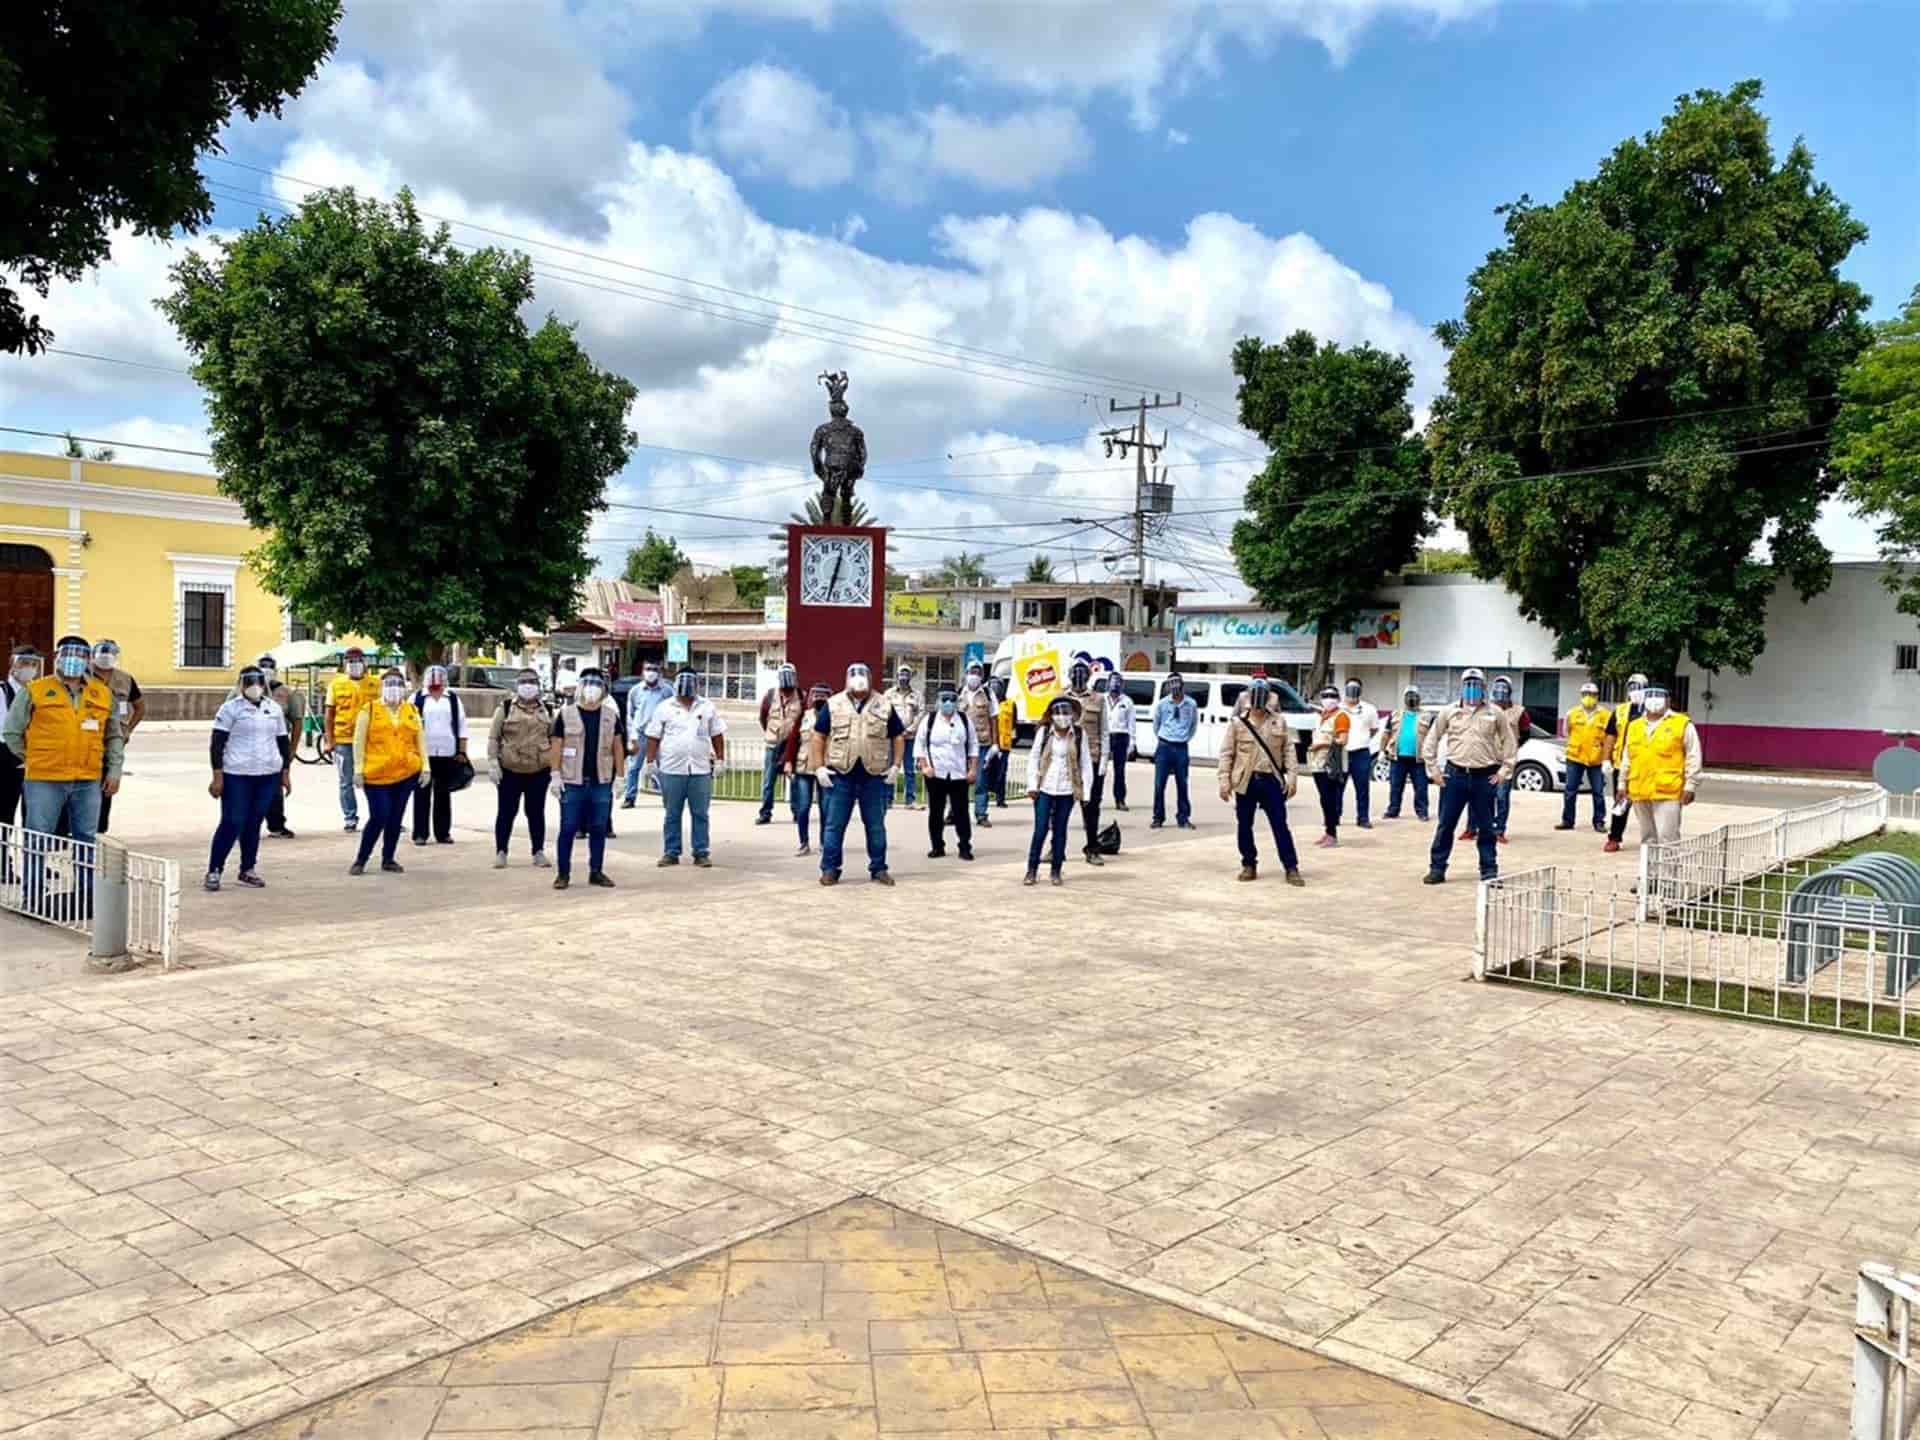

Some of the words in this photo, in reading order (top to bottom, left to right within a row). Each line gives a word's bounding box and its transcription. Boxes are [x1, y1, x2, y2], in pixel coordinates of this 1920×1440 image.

[854, 553, 862, 563] 2
[808, 565, 815, 574] 9
[858, 566, 866, 576] 3
[854, 578, 862, 588] 4
[833, 590, 840, 600] 6
[1223, 616, 1266, 635] Casi
